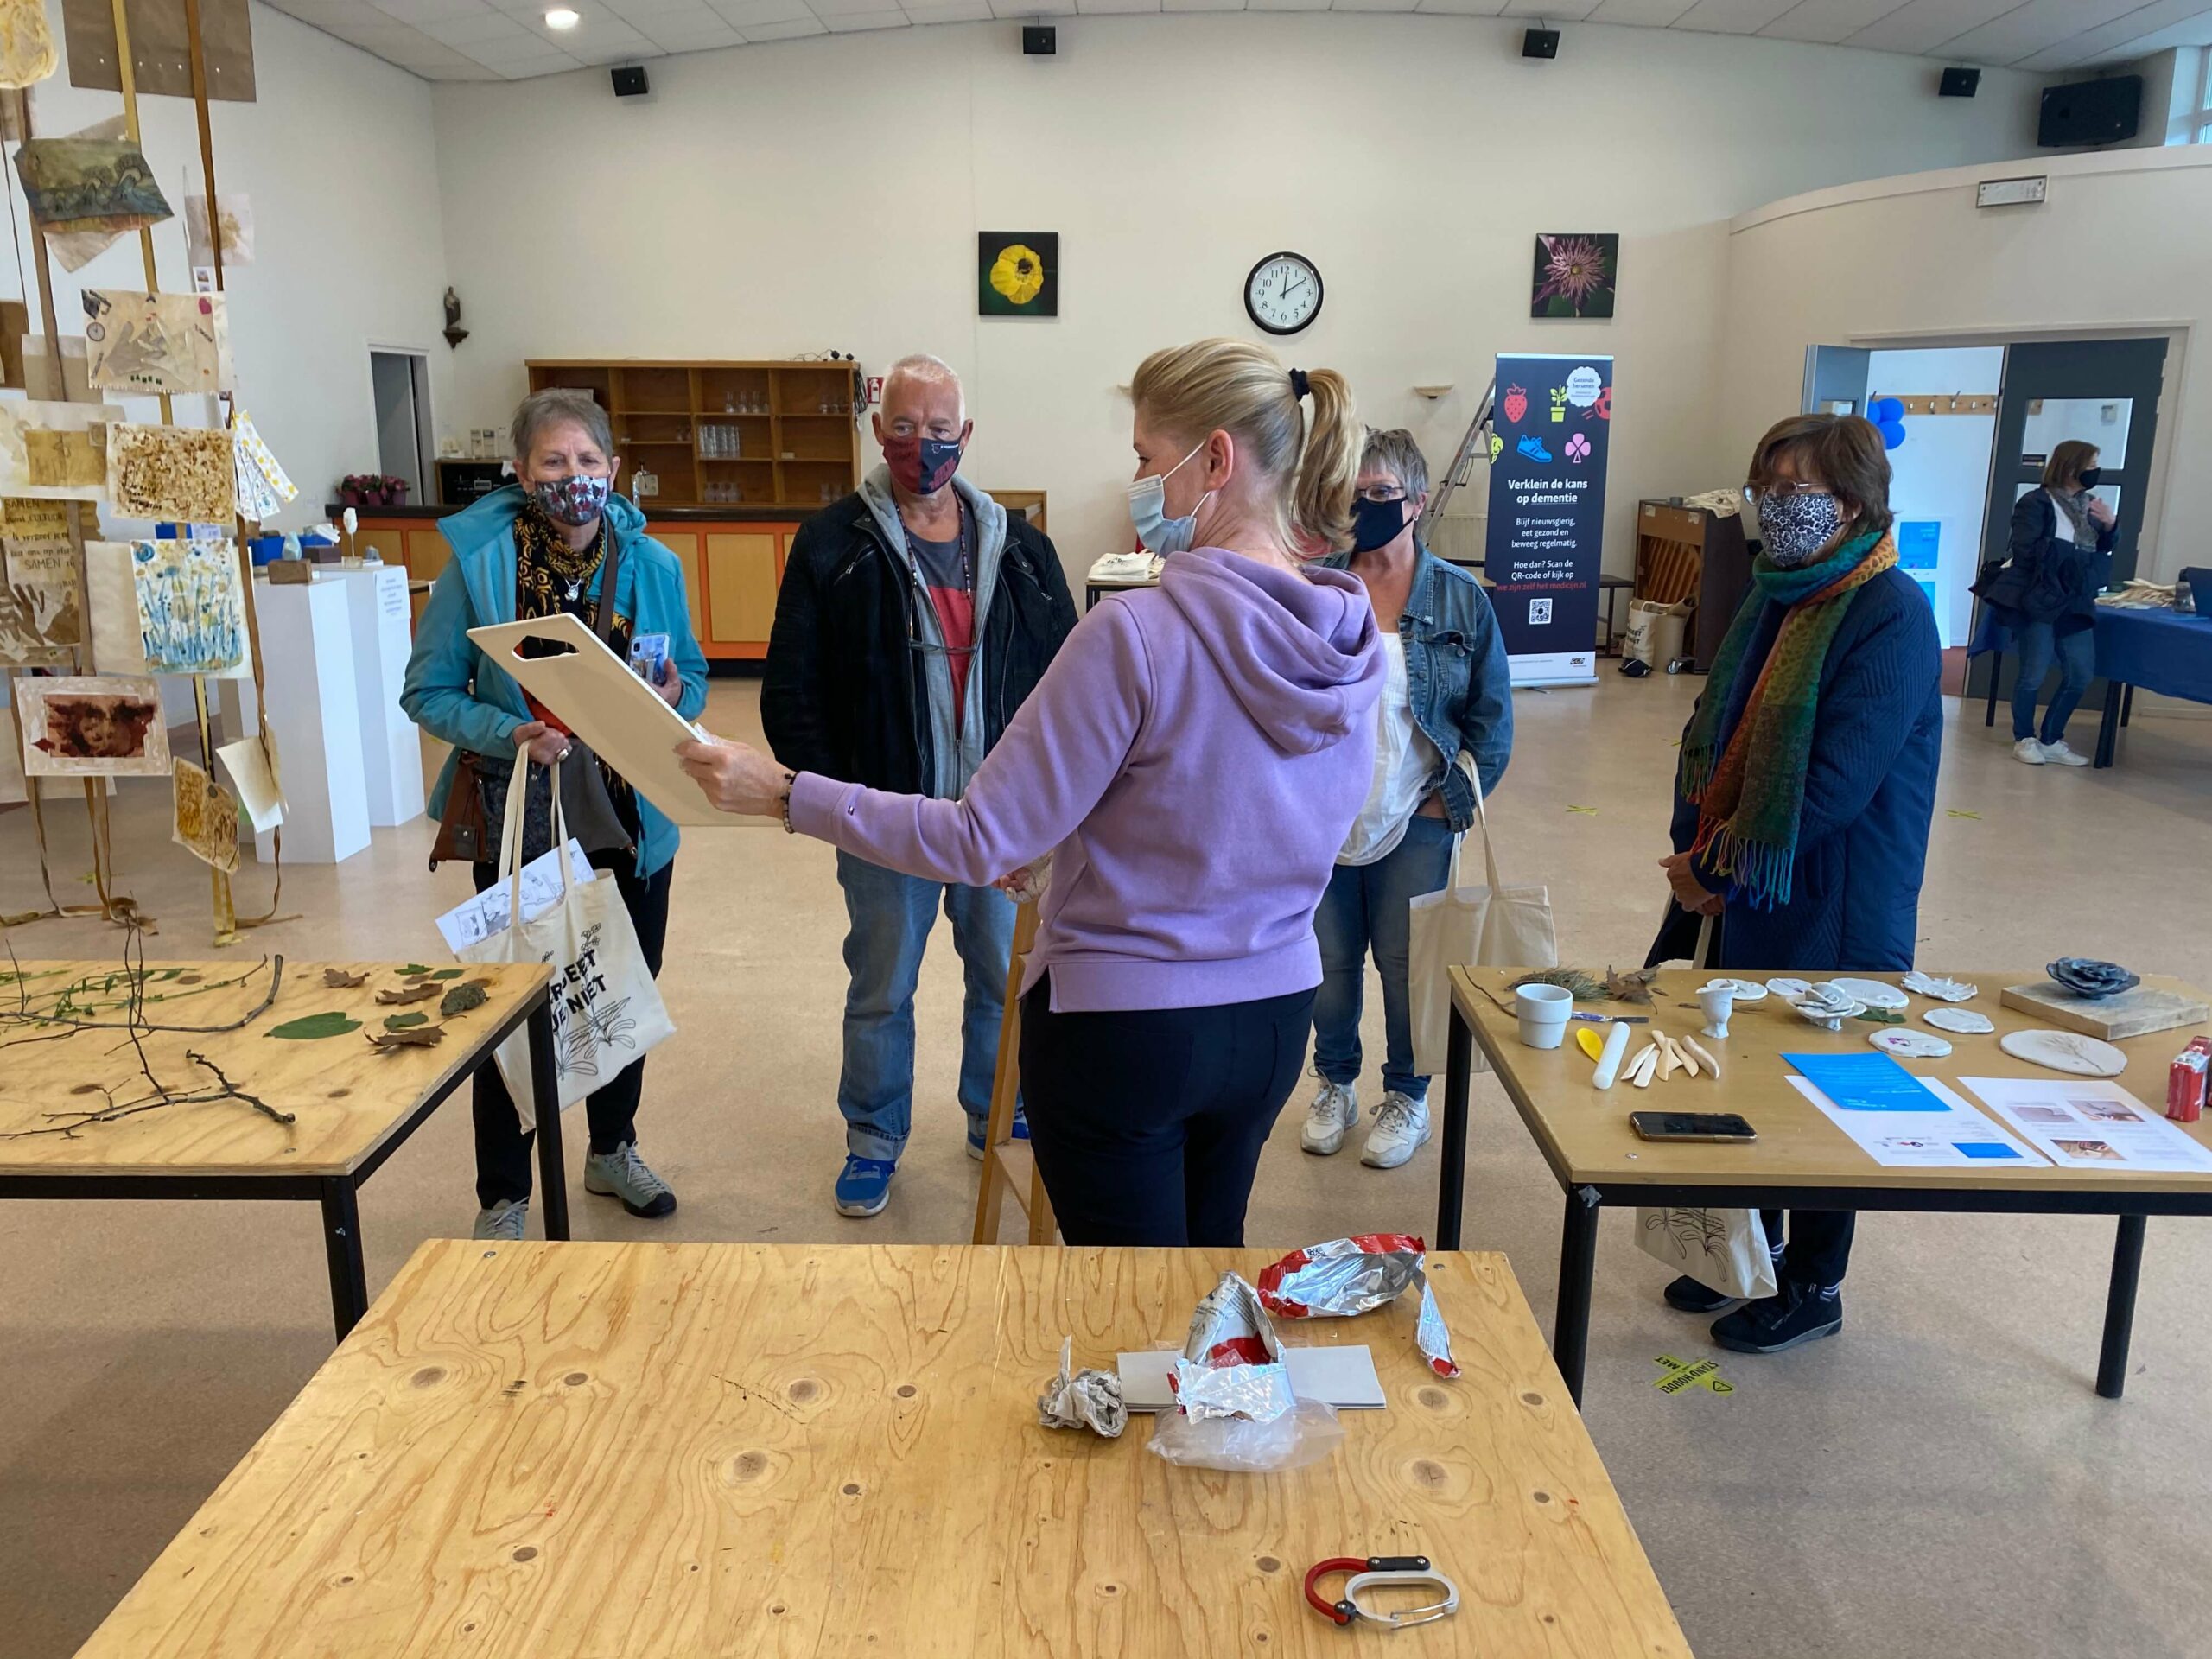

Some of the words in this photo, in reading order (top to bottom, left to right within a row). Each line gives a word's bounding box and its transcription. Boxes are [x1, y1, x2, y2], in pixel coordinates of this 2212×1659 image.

[1271, 269, 1278, 278] 11
[1281, 265, 1290, 275] 12
[1262, 278, 1272, 288] 10
[1258, 289, 1265, 298] 9
[1262, 300, 1268, 309] 8
[1300, 299, 1306, 309] 4
[1271, 308, 1276, 318] 7
[1281, 311, 1287, 321] 6
[1294, 308, 1299, 320] 5
[1507, 478, 1548, 490] Verklein
[1550, 478, 1563, 489] de
[1565, 478, 1588, 489] kans
[1516, 494, 1529, 506] op
[1531, 492, 1578, 503] dementie
[1516, 517, 1531, 527] Blijf
[1534, 528, 1560, 538] gezond
[1511, 539, 1539, 550] beweeg
[1529, 560, 1545, 569] dan?
[1564, 559, 1573, 568] de
[1510, 570, 1542, 582] QR-code
[1542, 570, 1551, 579] of
[1551, 570, 1564, 581] kijk
[1564, 571, 1574, 580] op
[566, 974, 607, 1014] NIET
